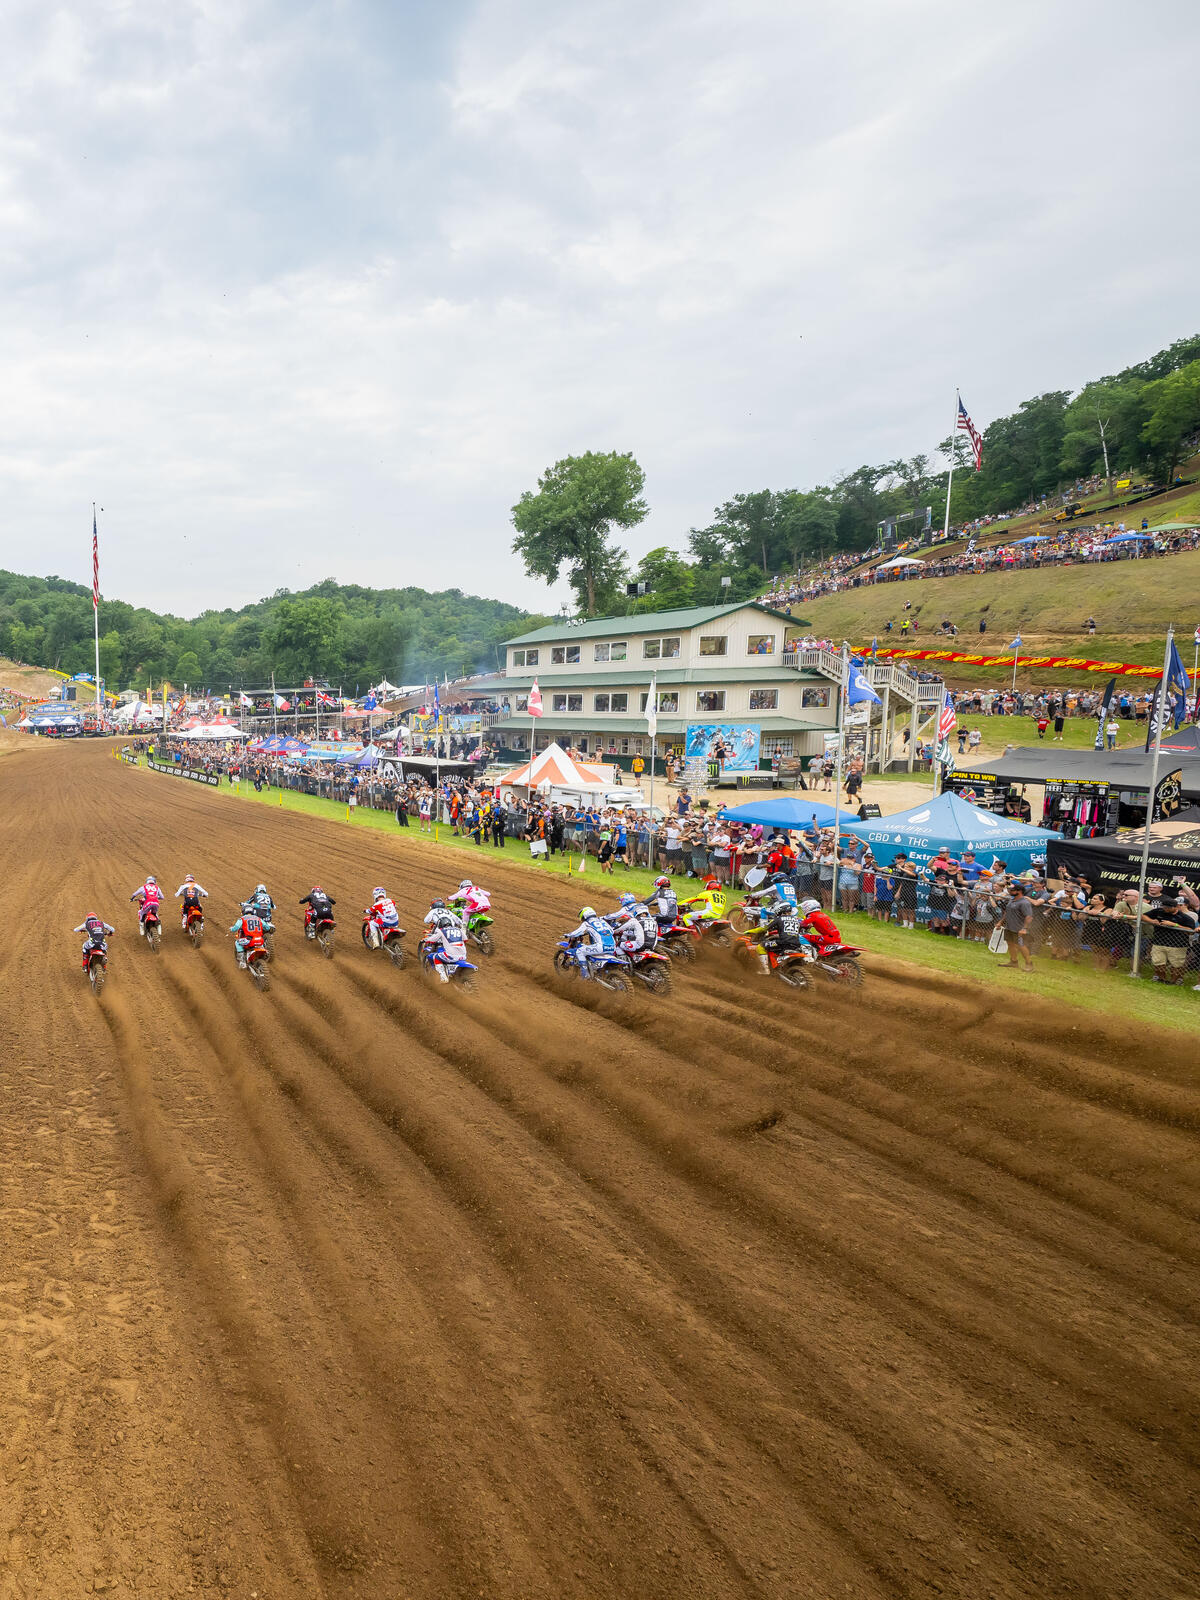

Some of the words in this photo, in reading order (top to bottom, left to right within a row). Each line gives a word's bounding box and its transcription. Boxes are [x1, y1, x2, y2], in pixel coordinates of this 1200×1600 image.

[868, 832, 890, 841] CBD
[908, 836, 929, 847] THC
[712, 893, 726, 904] 65
[247, 920, 262, 931] 84
